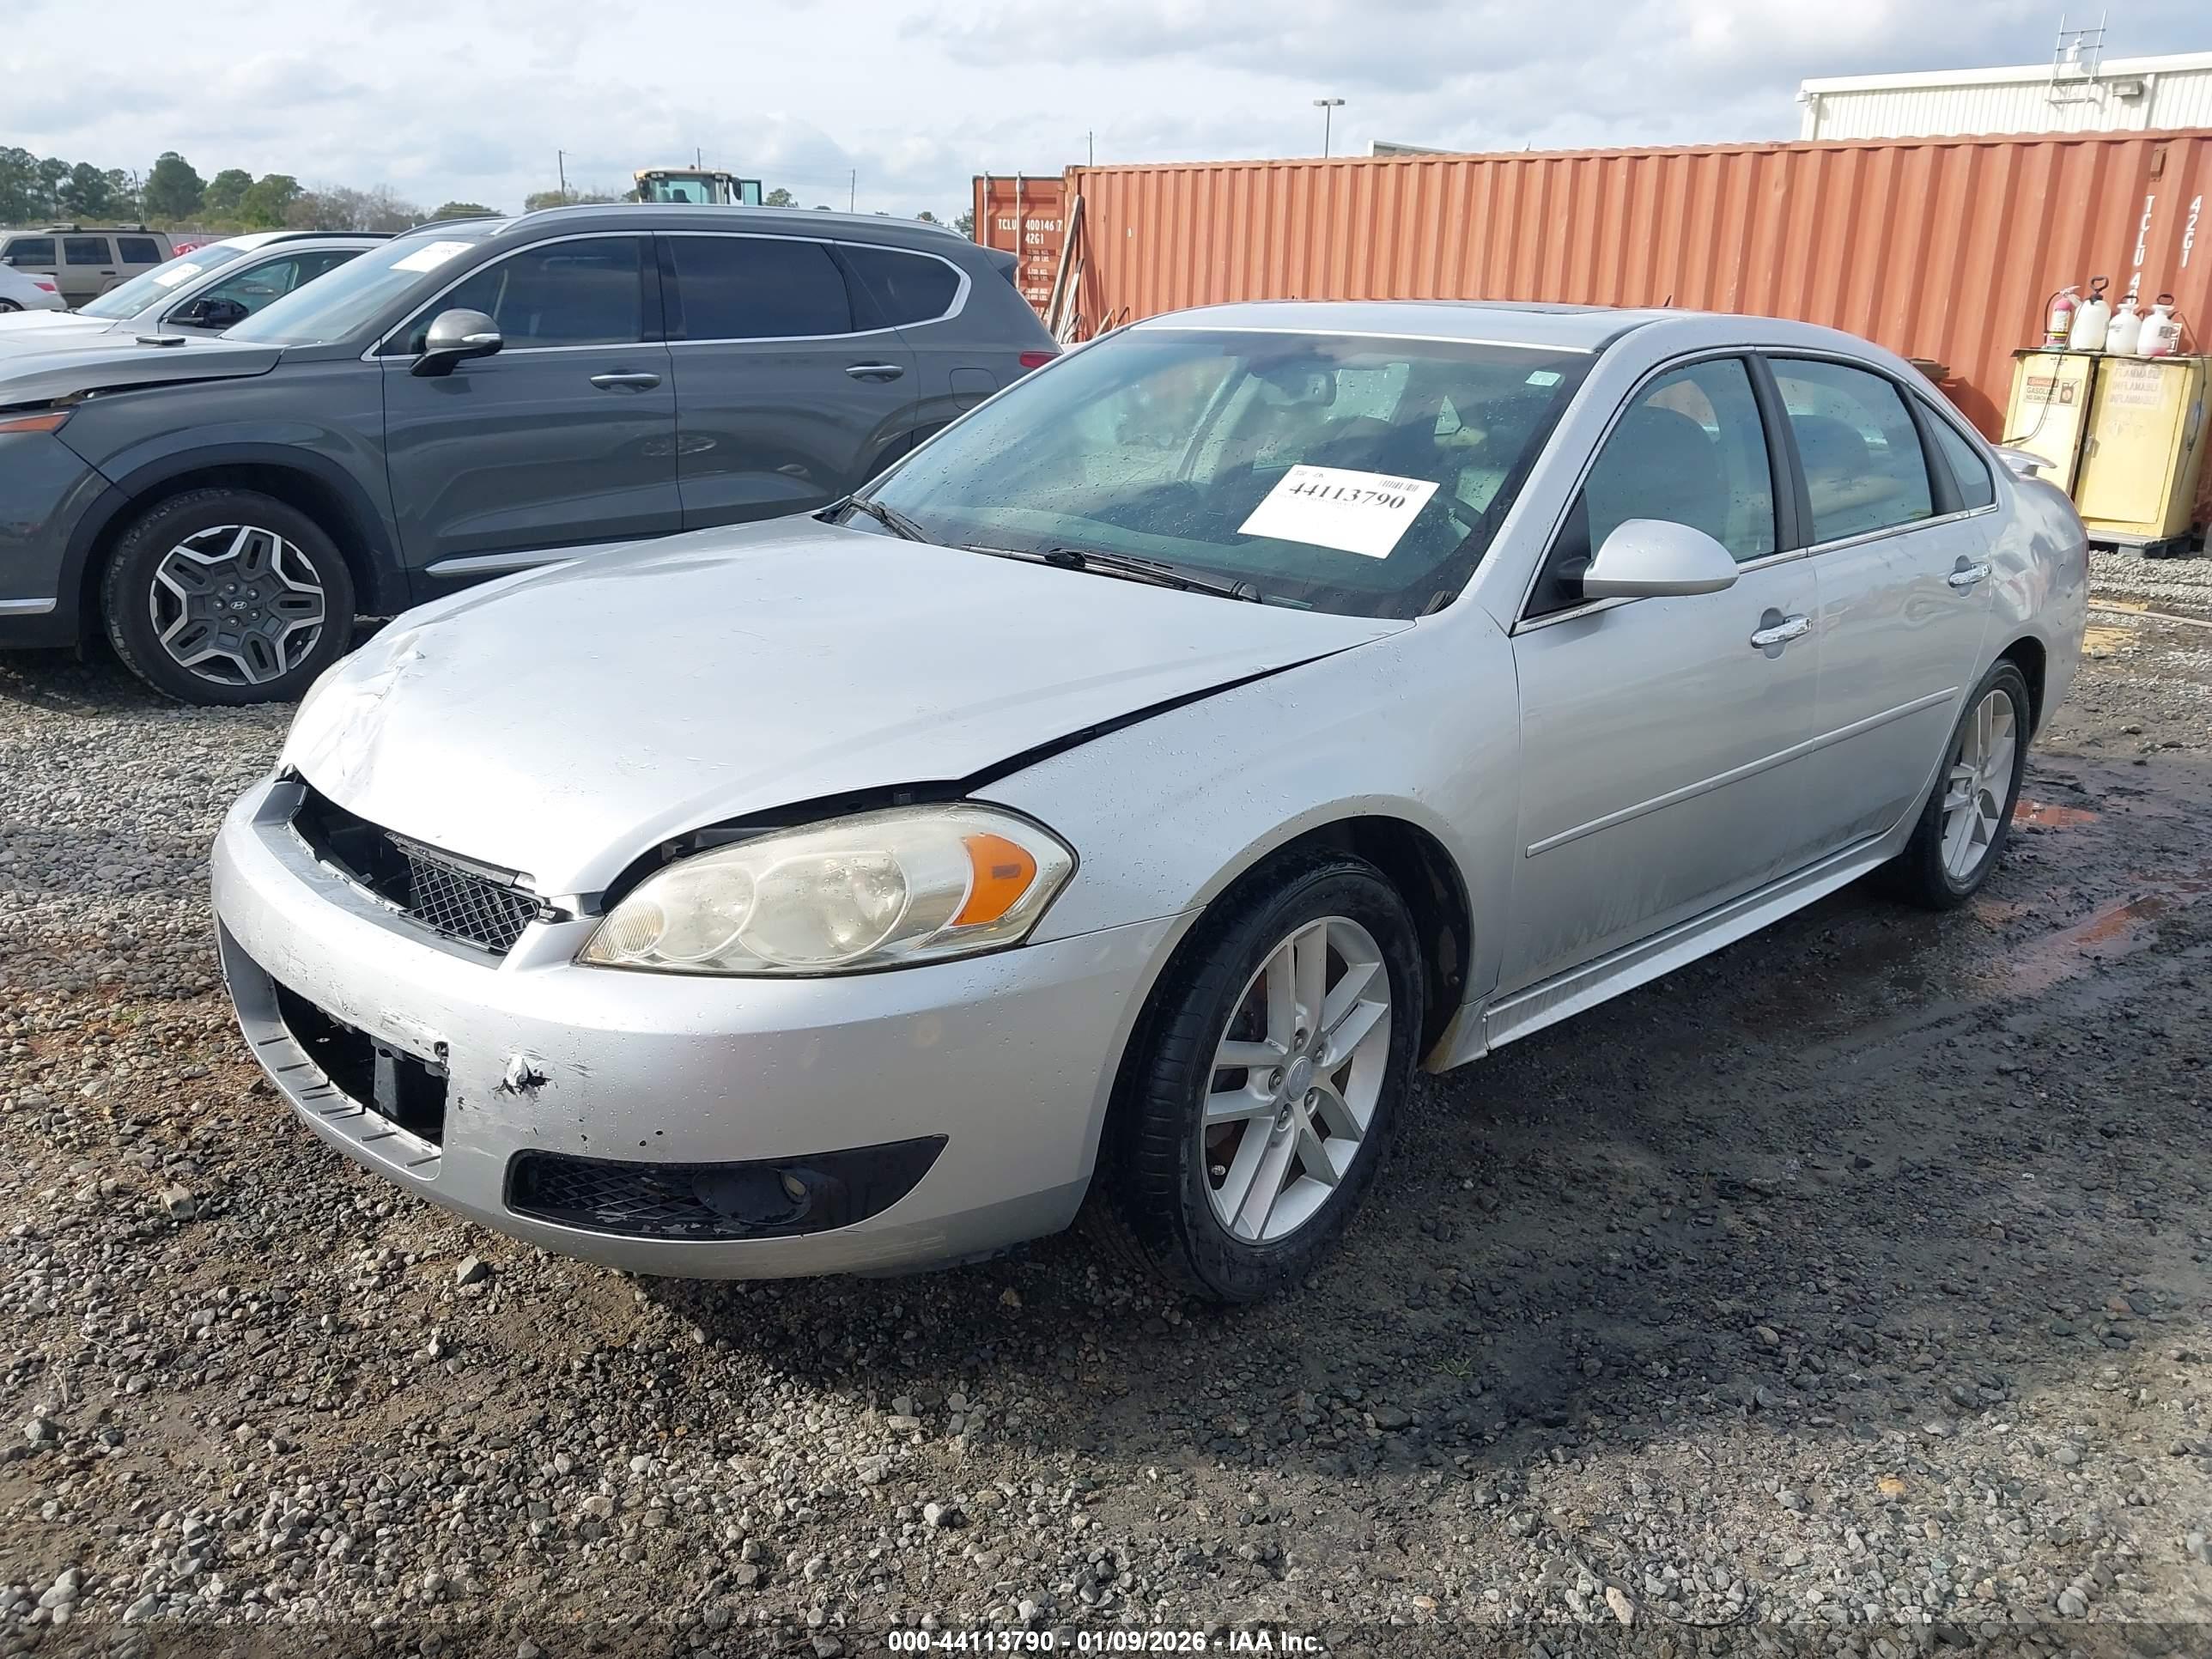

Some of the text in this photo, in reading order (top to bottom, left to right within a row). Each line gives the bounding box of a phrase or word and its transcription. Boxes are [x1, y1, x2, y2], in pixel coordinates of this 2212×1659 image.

[998, 218, 1017, 230] TCLU
[1025, 219, 1054, 231] 400146
[2133, 195, 2156, 266] TCLU
[2182, 195, 2203, 268] 42G1
[1024, 233, 1044, 245] 42G1
[1289, 482, 1407, 508] 44113790
